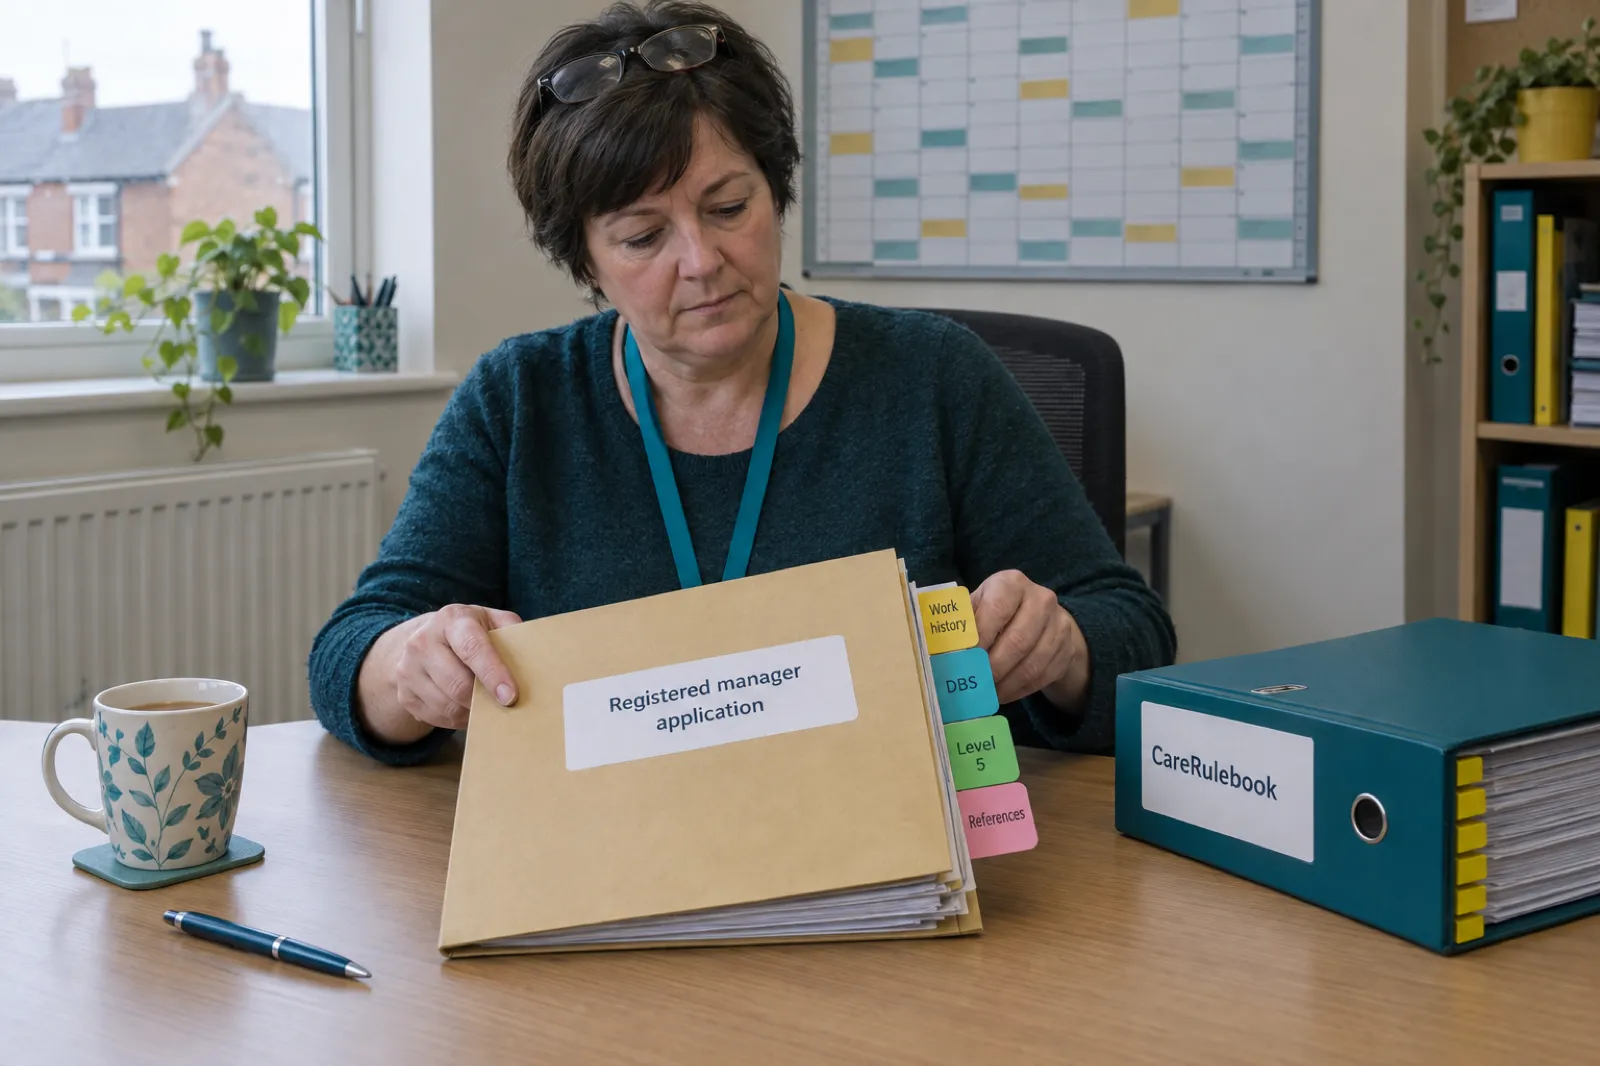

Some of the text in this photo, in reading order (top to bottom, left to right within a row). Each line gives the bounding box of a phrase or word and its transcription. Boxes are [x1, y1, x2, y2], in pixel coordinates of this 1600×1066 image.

[929, 600, 959, 616] Work
[929, 619, 967, 635] history
[609, 665, 802, 713] Registered manager
[946, 675, 978, 694] DBS
[656, 700, 765, 733] application
[956, 736, 996, 756] Level
[975, 757, 986, 772] 5
[1151, 744, 1278, 801] CareRulebook
[967, 809, 1026, 830] References
